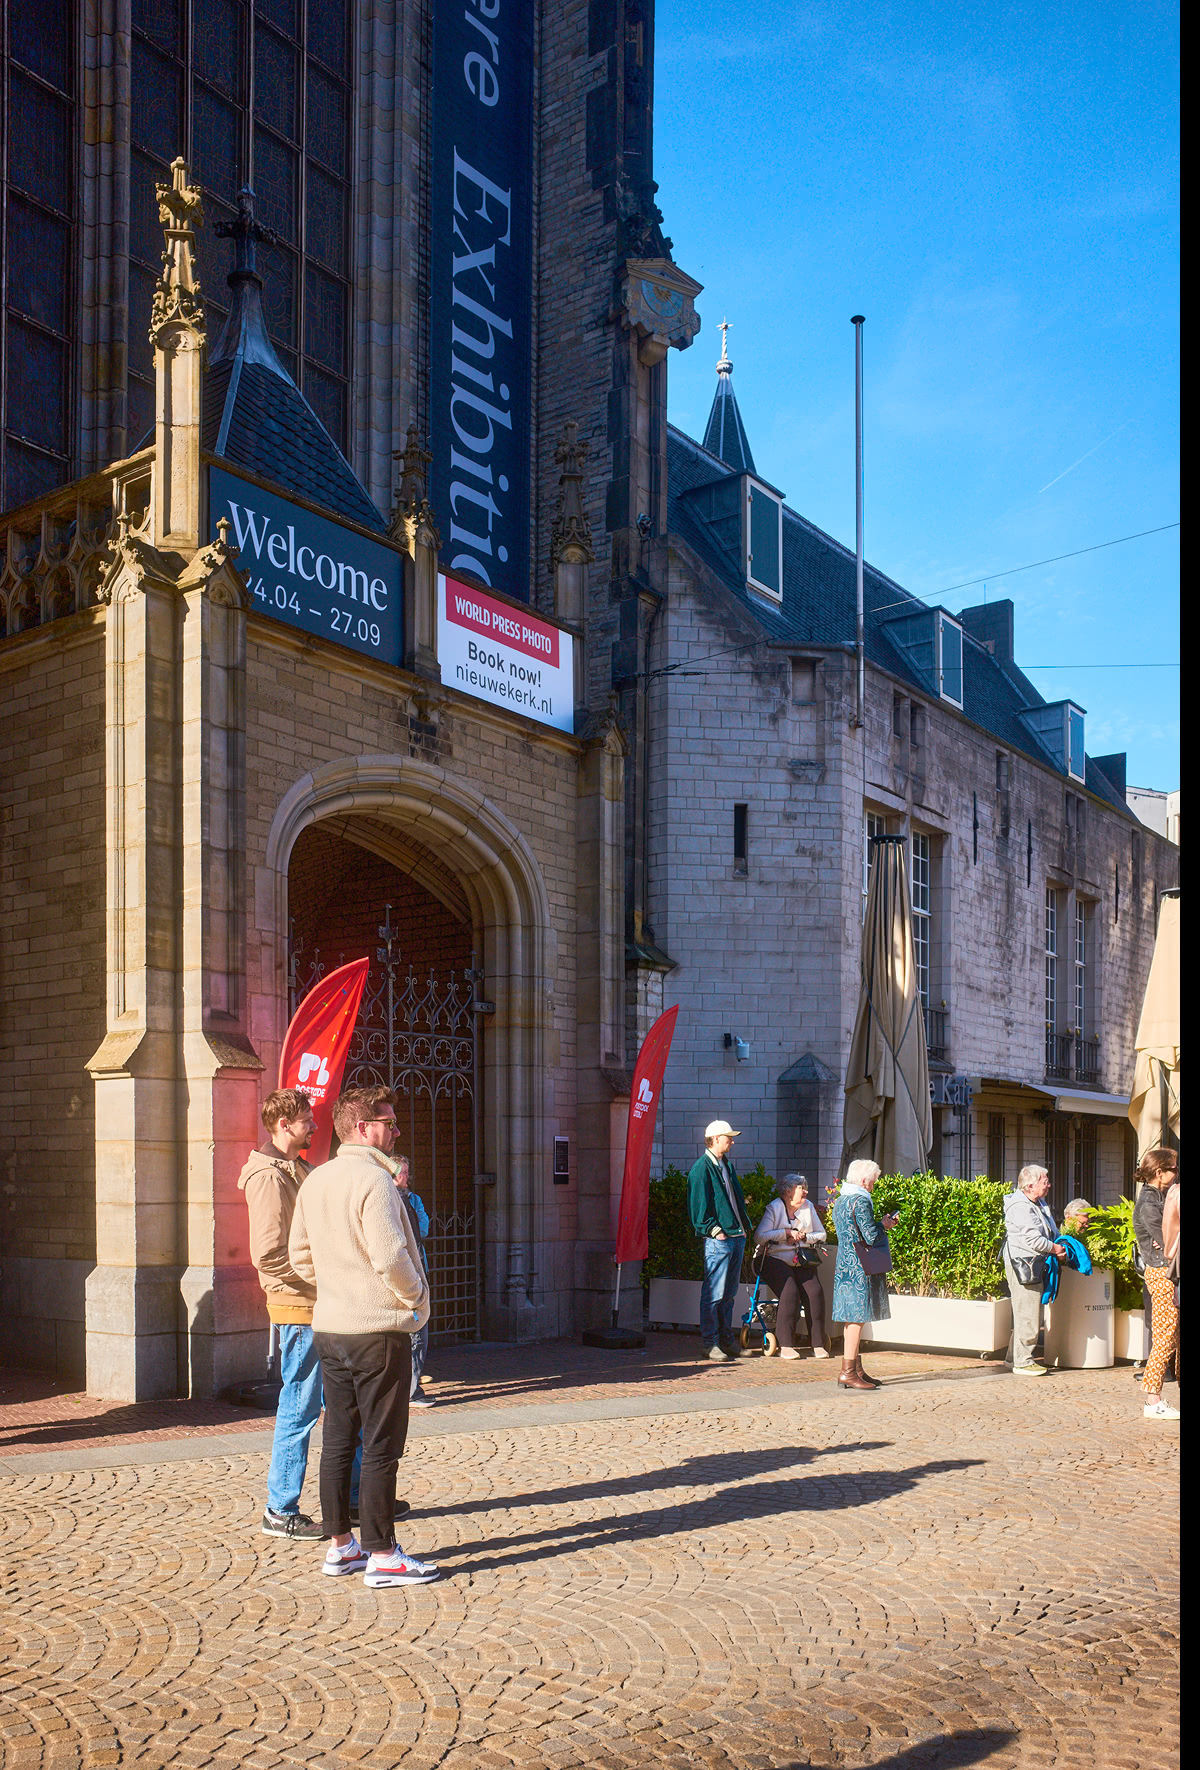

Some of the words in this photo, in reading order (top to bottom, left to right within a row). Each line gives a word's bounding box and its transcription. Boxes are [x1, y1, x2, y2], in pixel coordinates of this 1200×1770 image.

[227, 500, 388, 611] Welcome
[330, 607, 380, 646] 27.09
[455, 595, 491, 626] WORLD
[492, 612, 521, 640] PRESS
[522, 626, 552, 654] PHOTO
[456, 663, 553, 716] nieuwekerk.nl
[468, 640, 505, 673] Book
[509, 663, 541, 688] now!
